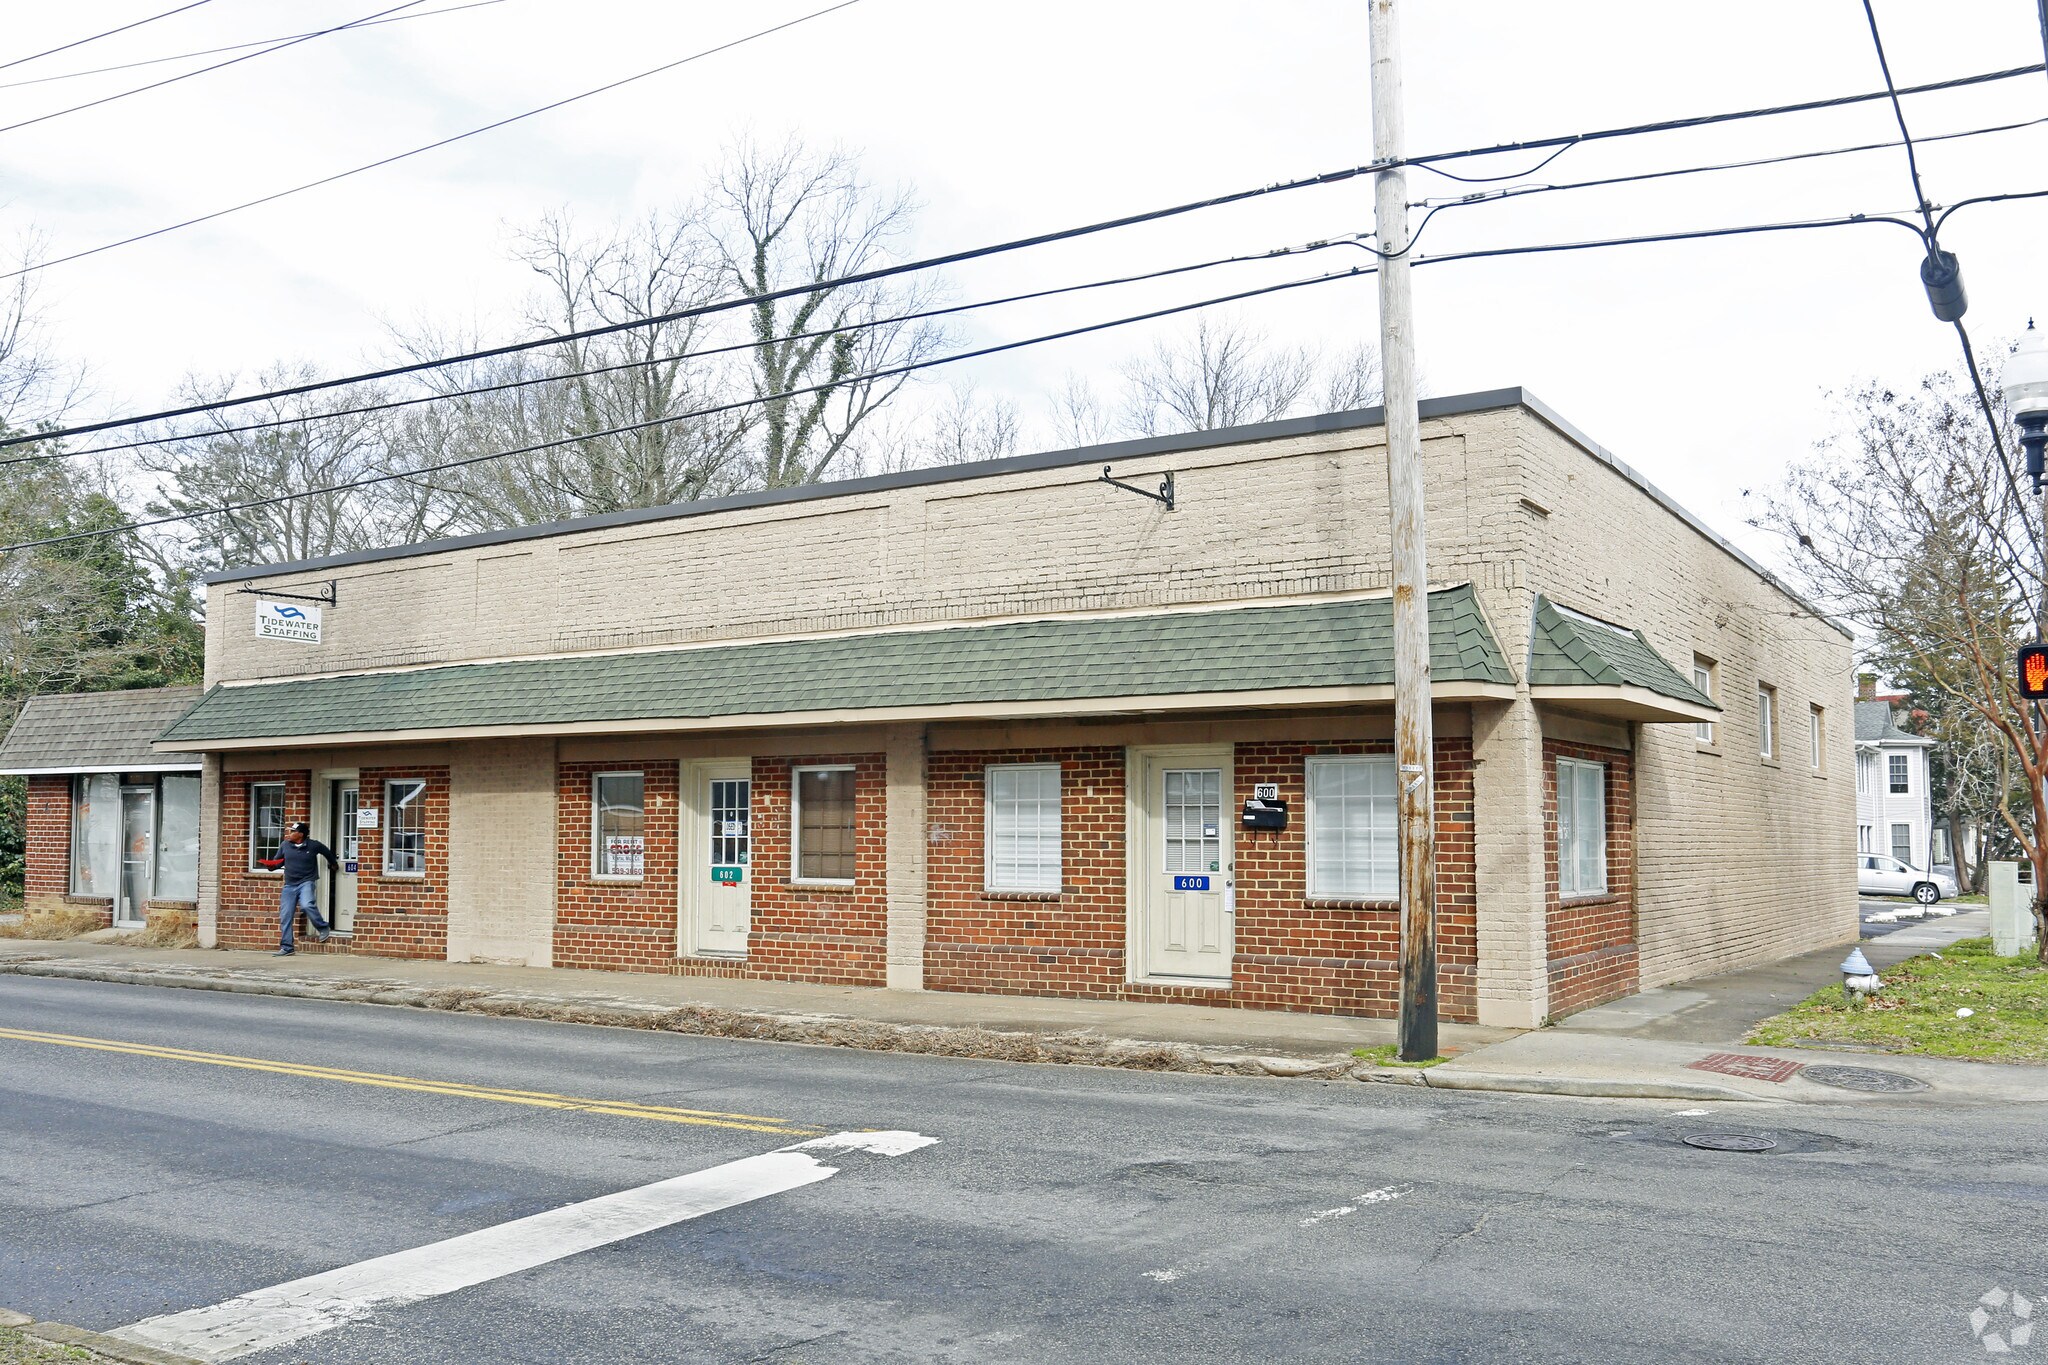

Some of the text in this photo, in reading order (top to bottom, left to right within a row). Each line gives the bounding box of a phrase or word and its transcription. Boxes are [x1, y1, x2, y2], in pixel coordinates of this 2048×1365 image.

[259, 615, 319, 631] TIDEWATER
[263, 624, 317, 639] STAFFING
[1257, 787, 1275, 798] 600
[610, 844, 642, 855] CROSS
[719, 870, 734, 879] 602
[1181, 877, 1203, 888] 600
